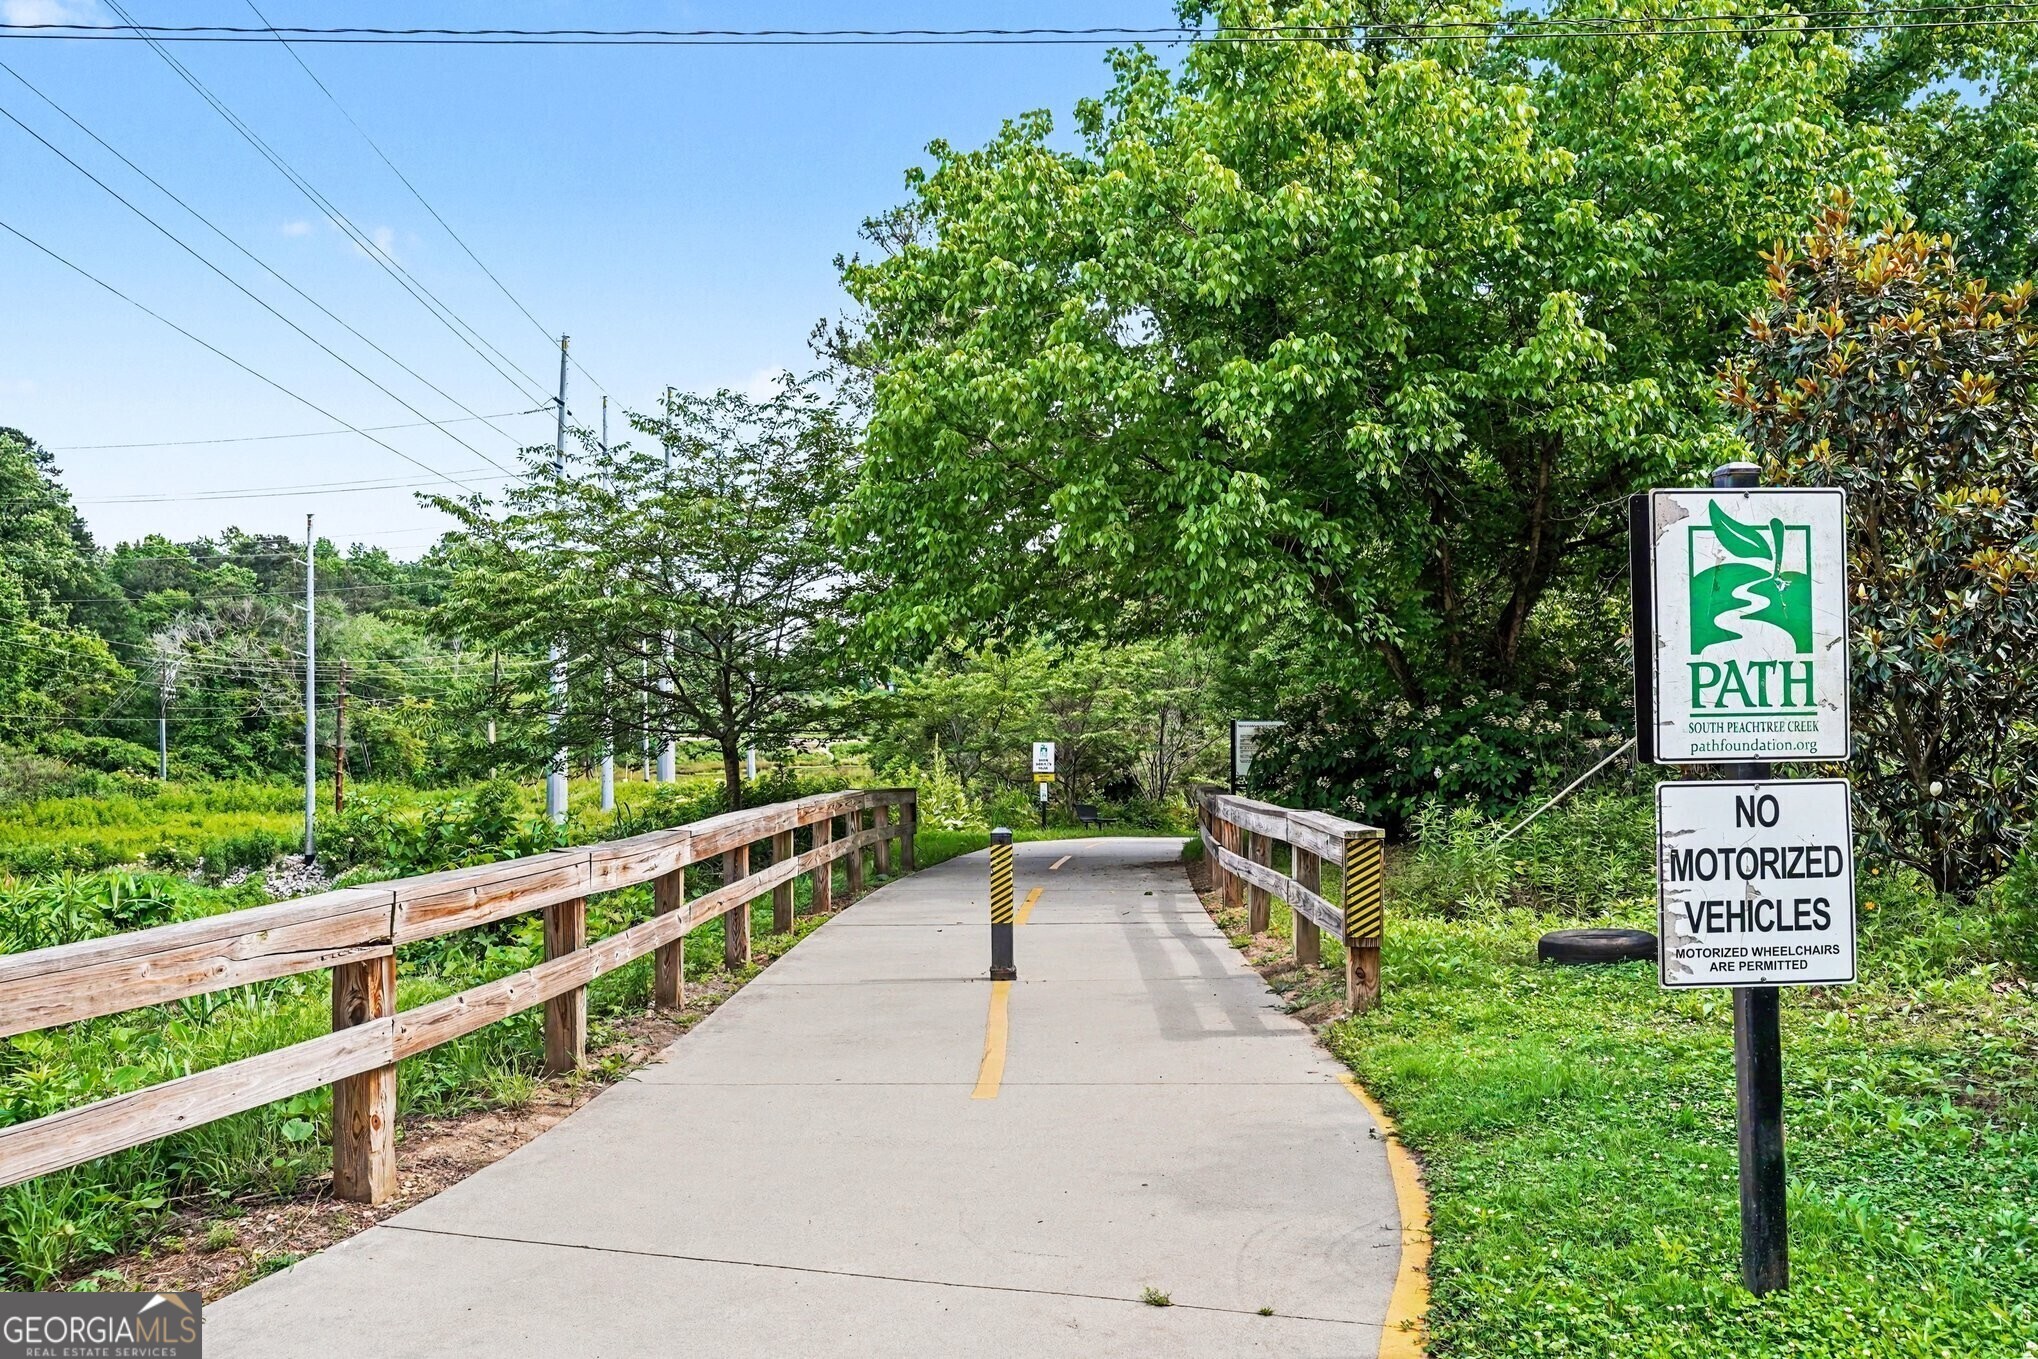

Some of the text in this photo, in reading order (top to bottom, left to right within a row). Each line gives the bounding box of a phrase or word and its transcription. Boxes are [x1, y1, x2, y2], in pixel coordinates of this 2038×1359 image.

[1686, 660, 1818, 708] PATH
[1688, 720, 1819, 734] SOUTH PEACHTREE CREEK
[1690, 738, 1818, 755] pathfoundation.org
[1735, 794, 1780, 828] NO
[1671, 845, 1843, 882] MOTORIZED
[1684, 897, 1831, 934] VEHICLES
[1676, 944, 1840, 959] MOTORIZED WHEELCHAIRS
[1709, 959, 1808, 972] ARE PERMITTED
